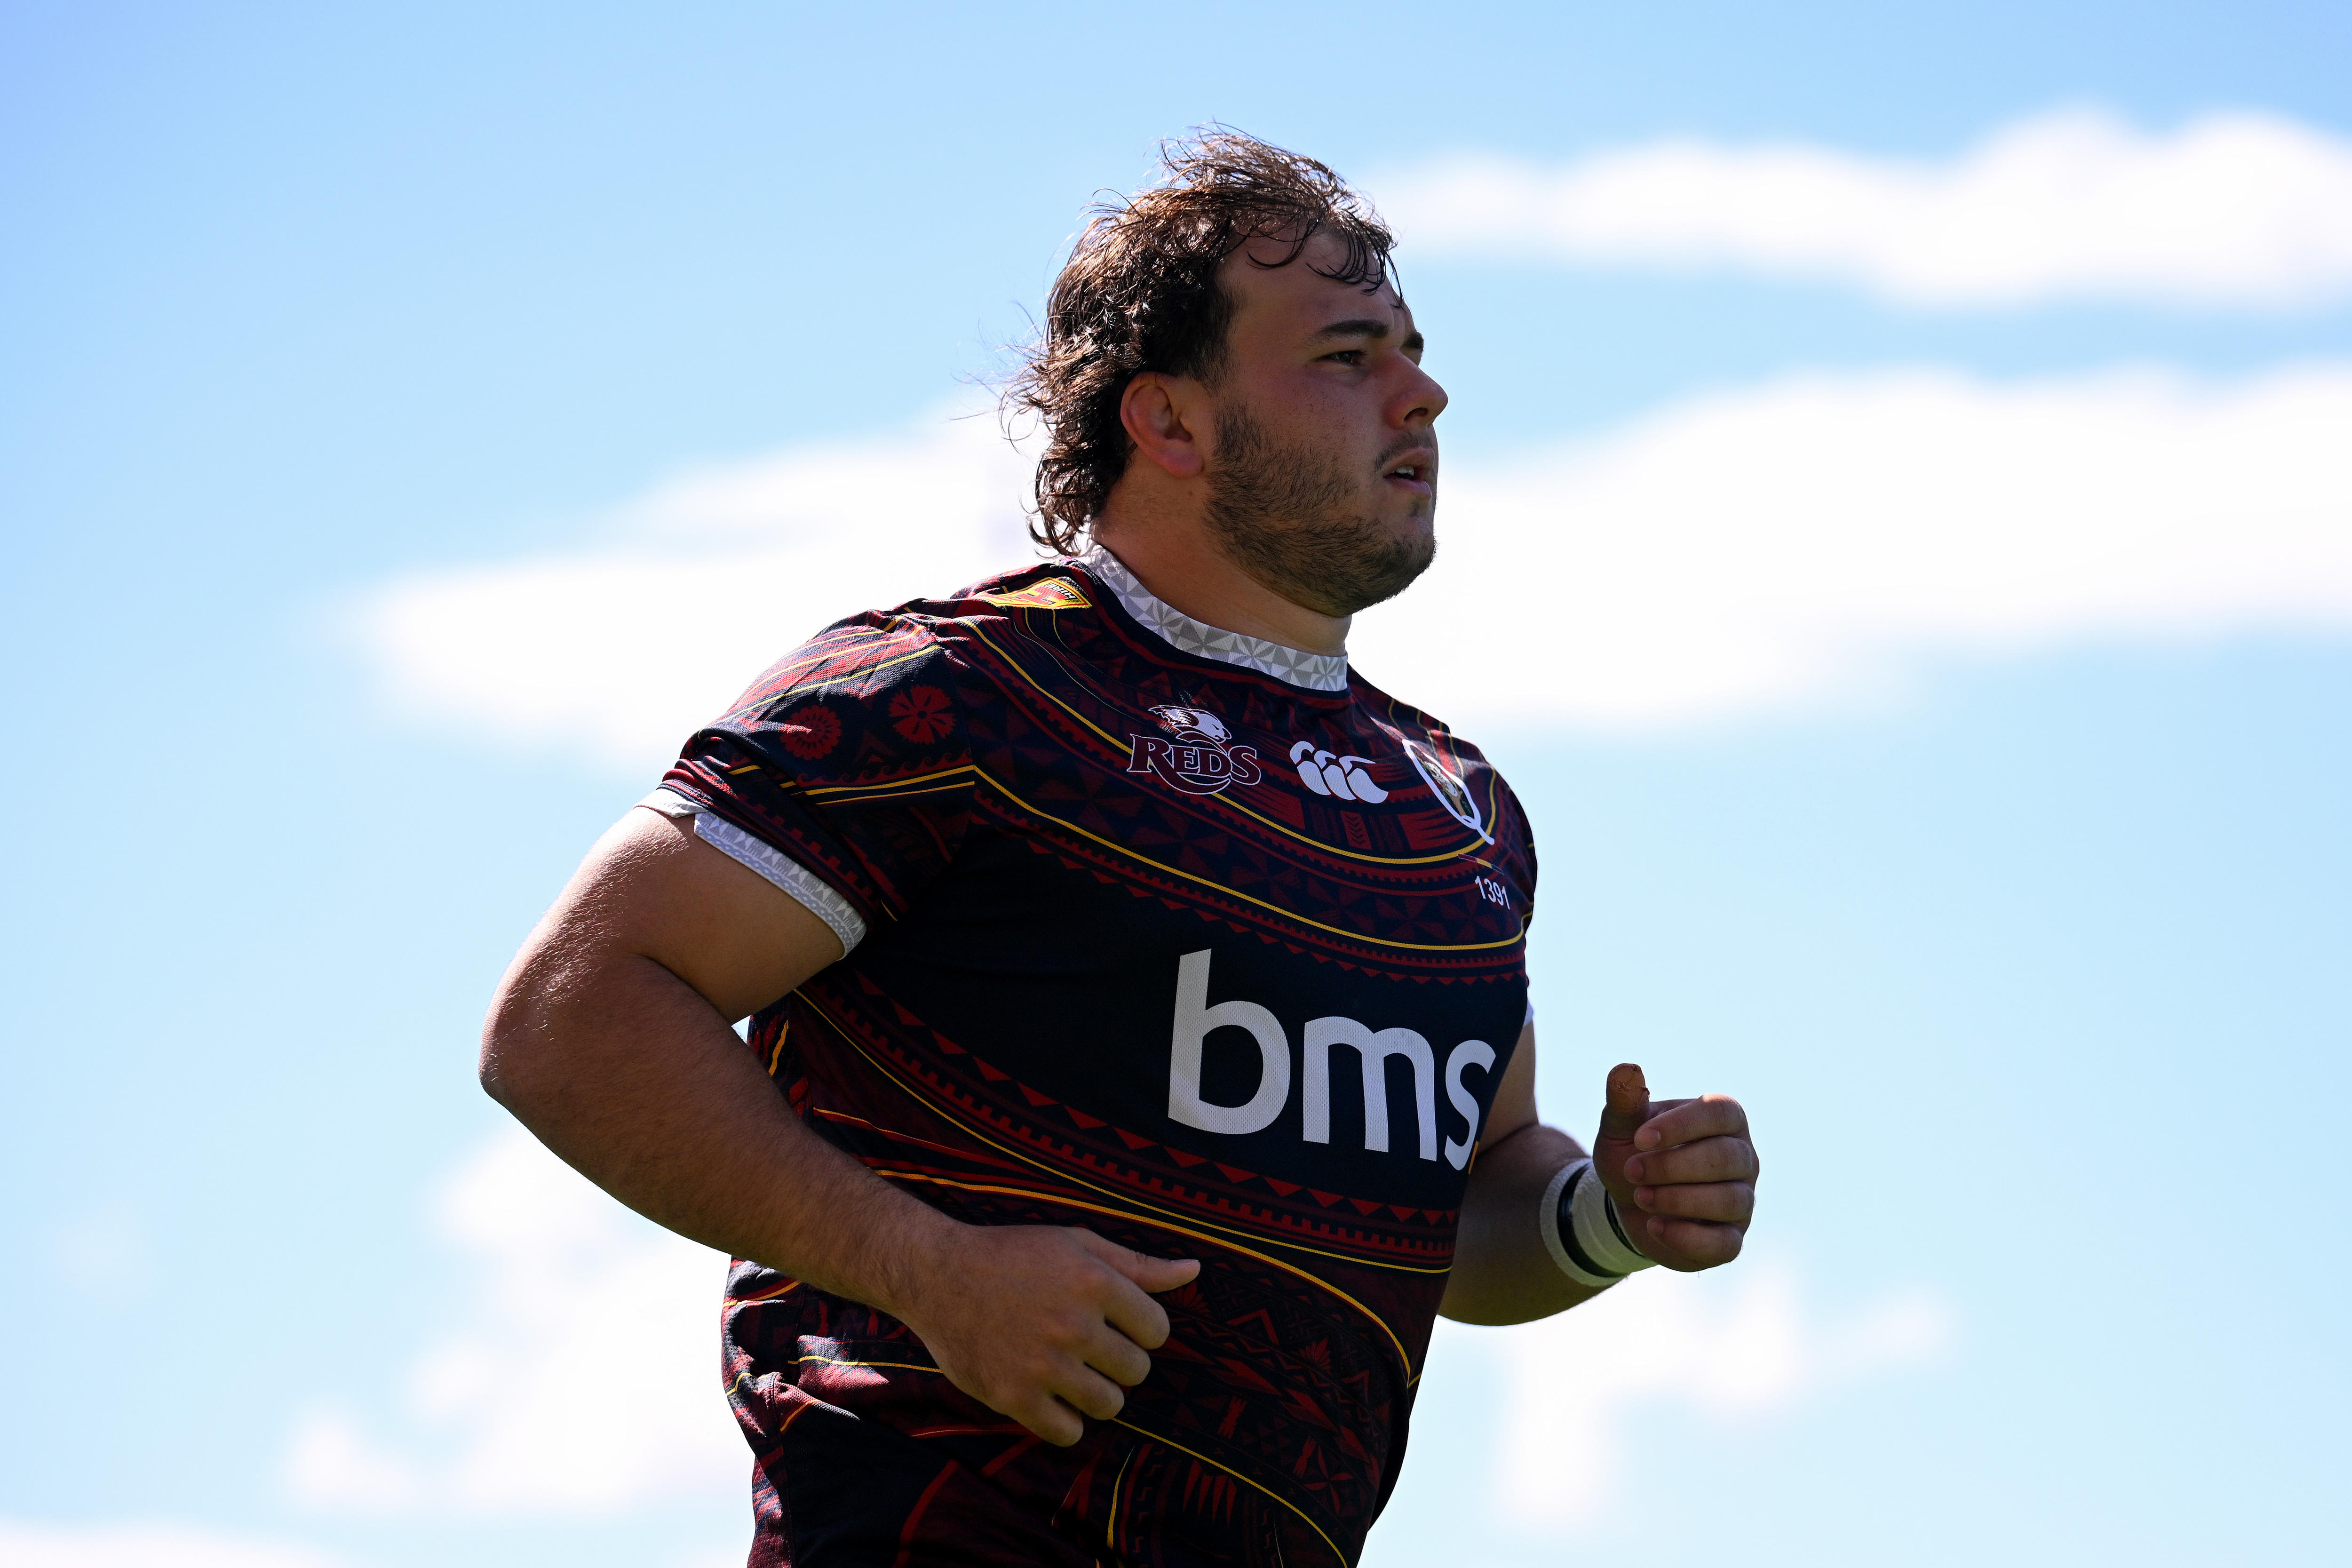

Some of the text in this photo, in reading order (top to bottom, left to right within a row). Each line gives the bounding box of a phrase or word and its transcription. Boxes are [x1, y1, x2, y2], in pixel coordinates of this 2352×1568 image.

[1044, 583, 1076, 598] HIRE
[1127, 733, 1261, 795] REDS
[1475, 875, 1510, 910] 1391
[1168, 948, 1496, 1170] bms
